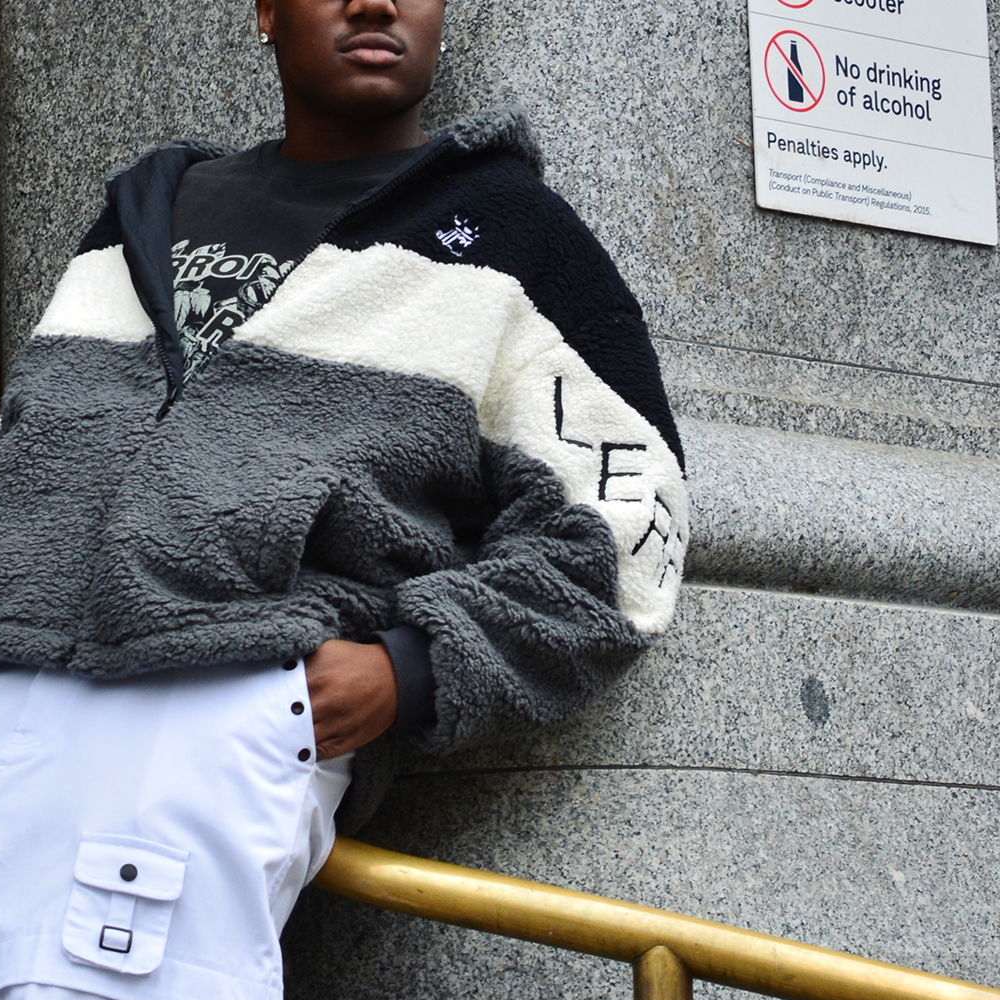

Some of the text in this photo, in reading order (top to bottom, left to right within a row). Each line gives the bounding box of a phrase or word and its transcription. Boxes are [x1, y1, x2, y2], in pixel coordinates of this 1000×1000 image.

[834, 54, 942, 101] No drinking
[836, 86, 932, 122] of alcohol
[766, 131, 888, 173] Penalties apply.
[768, 168, 912, 202] Transport (Compliance and Miscellaneous)
[768, 180, 932, 216] (Conduct on Public Transport) Regulations, 2015.
